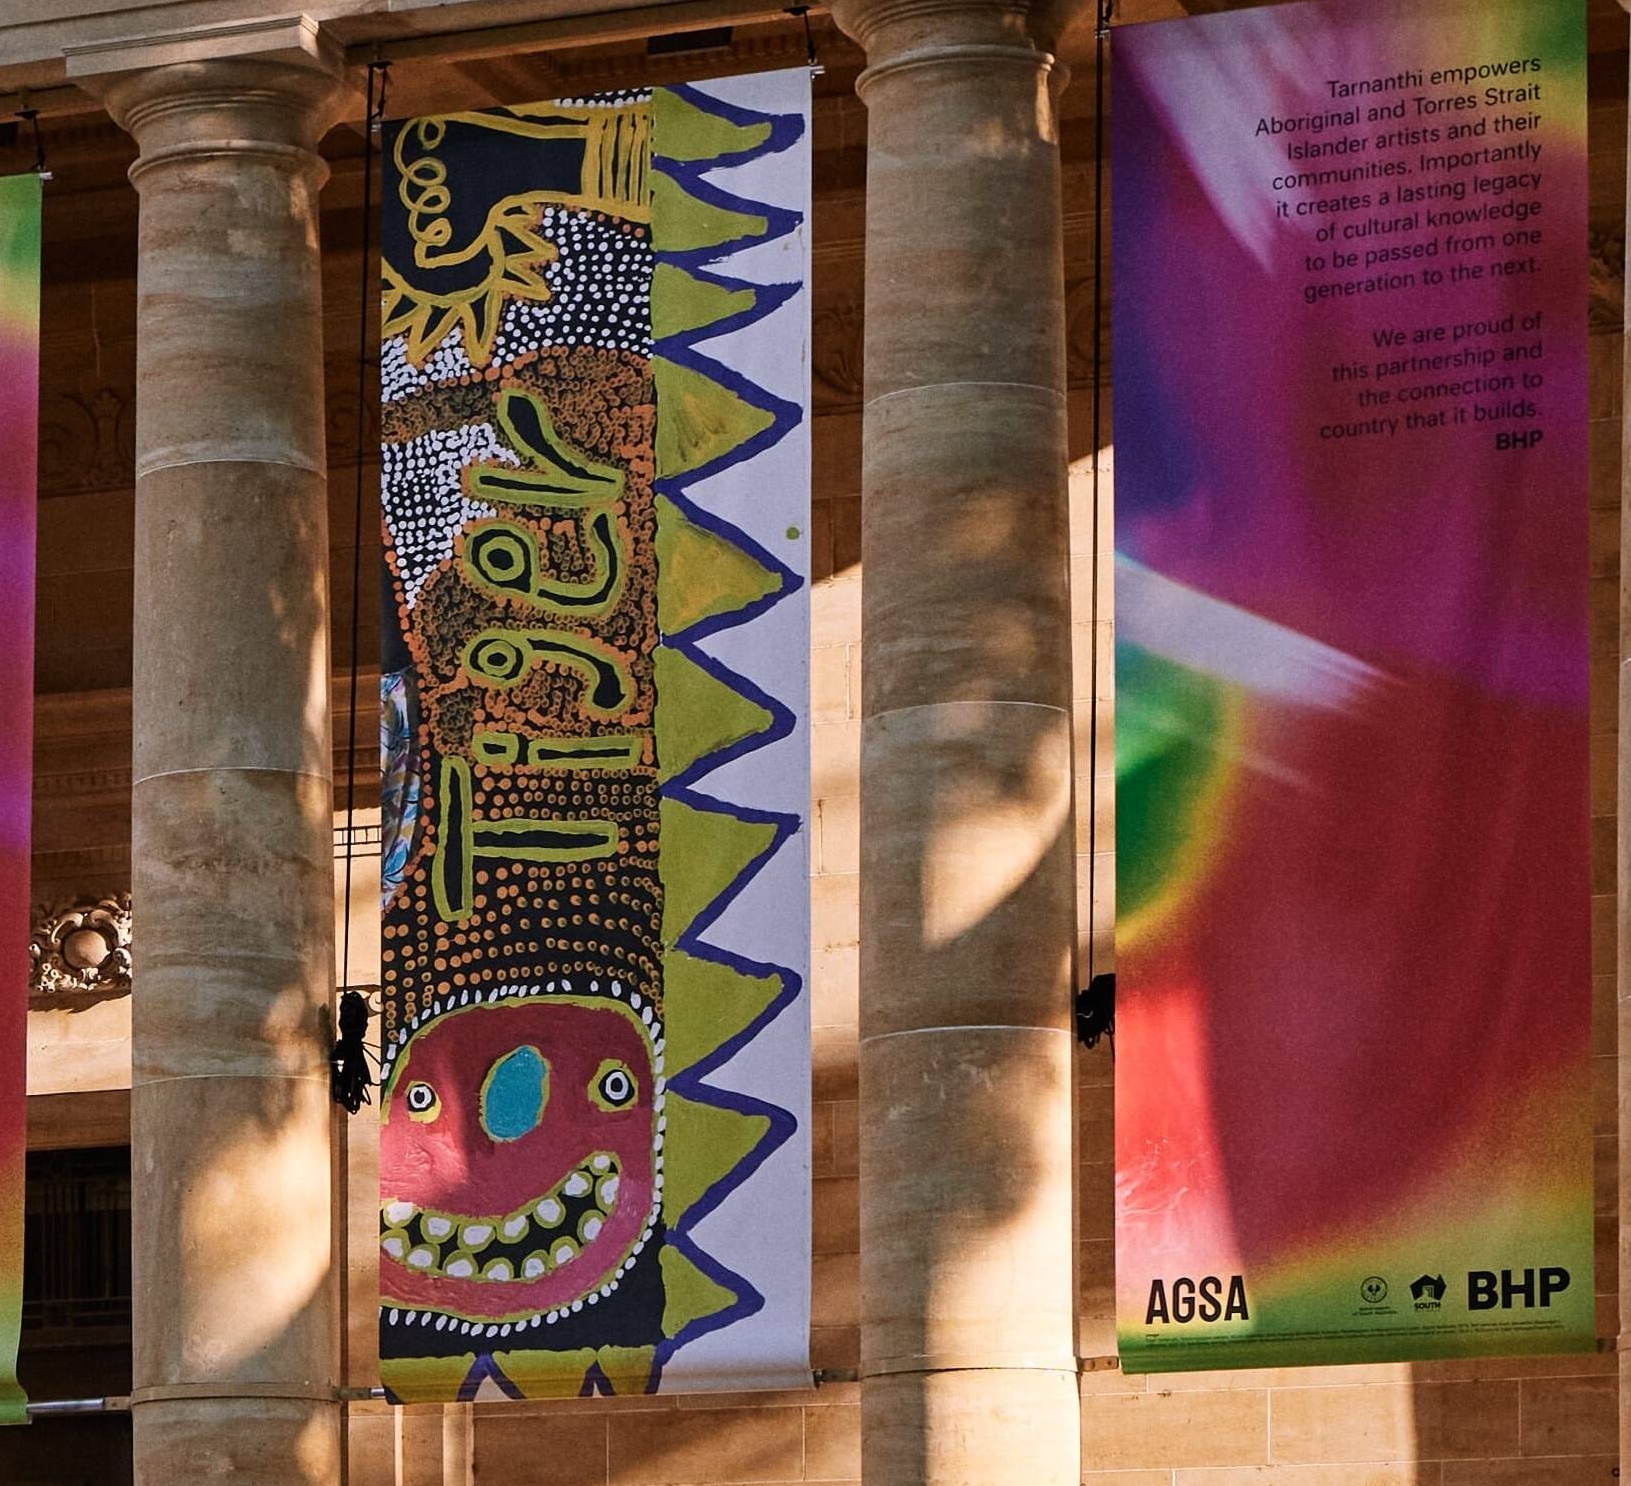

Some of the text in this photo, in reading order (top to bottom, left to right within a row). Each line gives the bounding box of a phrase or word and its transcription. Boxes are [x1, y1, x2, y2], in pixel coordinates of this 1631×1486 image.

[1328, 57, 1541, 98] Tarnanthi empowers
[1255, 83, 1541, 136] Aboriginal and Torres Strait
[1288, 113, 1542, 160] Islander artists and their
[1273, 140, 1542, 190] communities. Importantly
[1276, 172, 1542, 218] it creates a lasting legacy
[1316, 200, 1542, 242] of cultural knowledge
[1305, 229, 1542, 272] to be passed from one
[1304, 272, 1415, 303] generation
[1423, 268, 1443, 285] to
[1451, 262, 1483, 282] the
[1374, 311, 1543, 348] We are proud of
[1332, 341, 1543, 382] this partnership and
[1358, 372, 1543, 407] the connection to
[1320, 416, 1398, 439] country
[1406, 411, 1445, 429] that
[1454, 408, 1467, 424] it
[1495, 430, 1543, 450] BHP
[1145, 1275, 1250, 1325] AGSA
[1468, 1267, 1570, 1310] BHP
